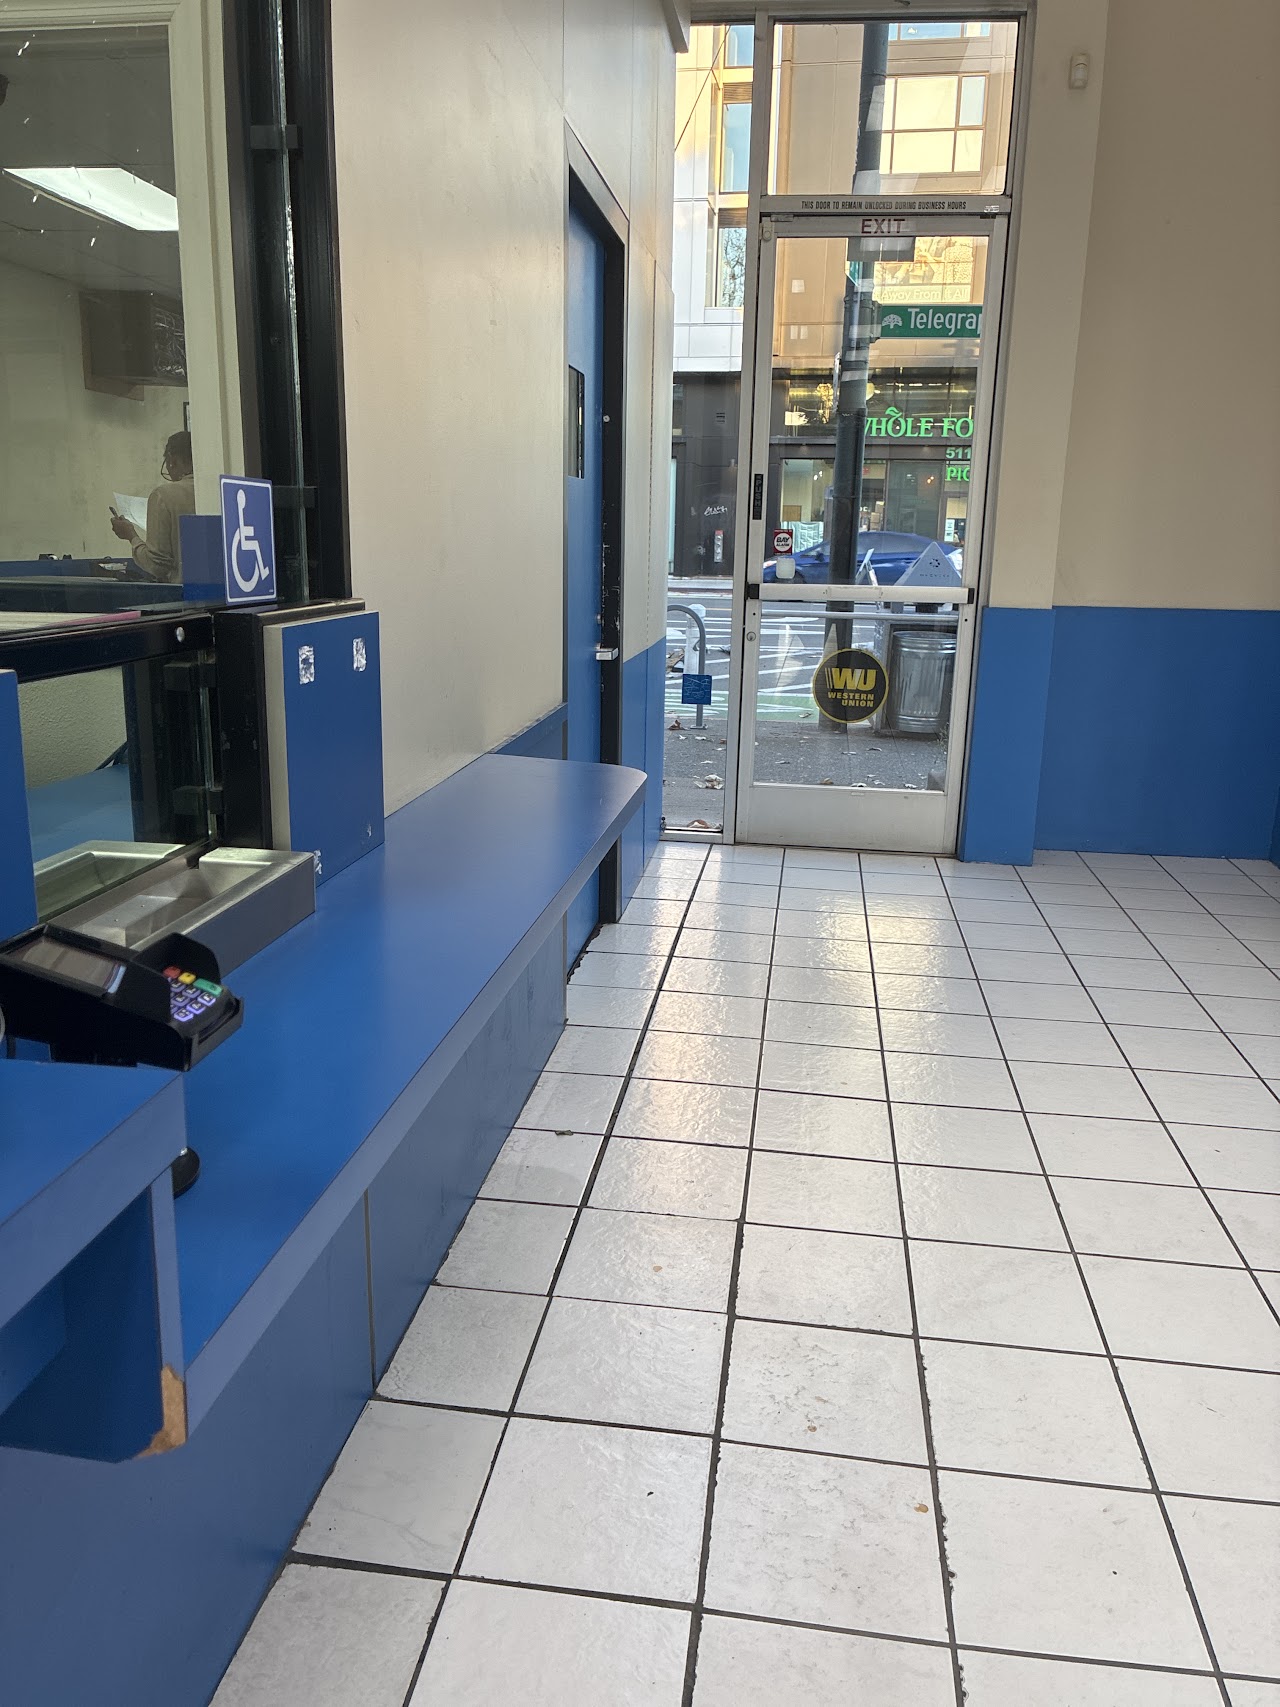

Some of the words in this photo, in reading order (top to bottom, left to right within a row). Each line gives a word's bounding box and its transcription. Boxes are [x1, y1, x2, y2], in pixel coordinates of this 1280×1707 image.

[801, 201, 813, 209] THIS
[815, 201, 831, 209] DOOR
[832, 201, 840, 209] TO
[841, 201, 863, 209] REMAIN
[864, 201, 893, 209] UNLOCKED
[894, 201, 916, 209] DURING
[917, 201, 946, 209] BUSINESS
[947, 201, 967, 209] HOURS
[861, 218, 906, 234] EXIT
[881, 289, 911, 301] Away
[913, 289, 941, 299] From
[953, 288, 968, 298] All
[830, 667, 877, 691] WU
[827, 691, 875, 700] WESTERN
[841, 699, 874, 708] UNION
